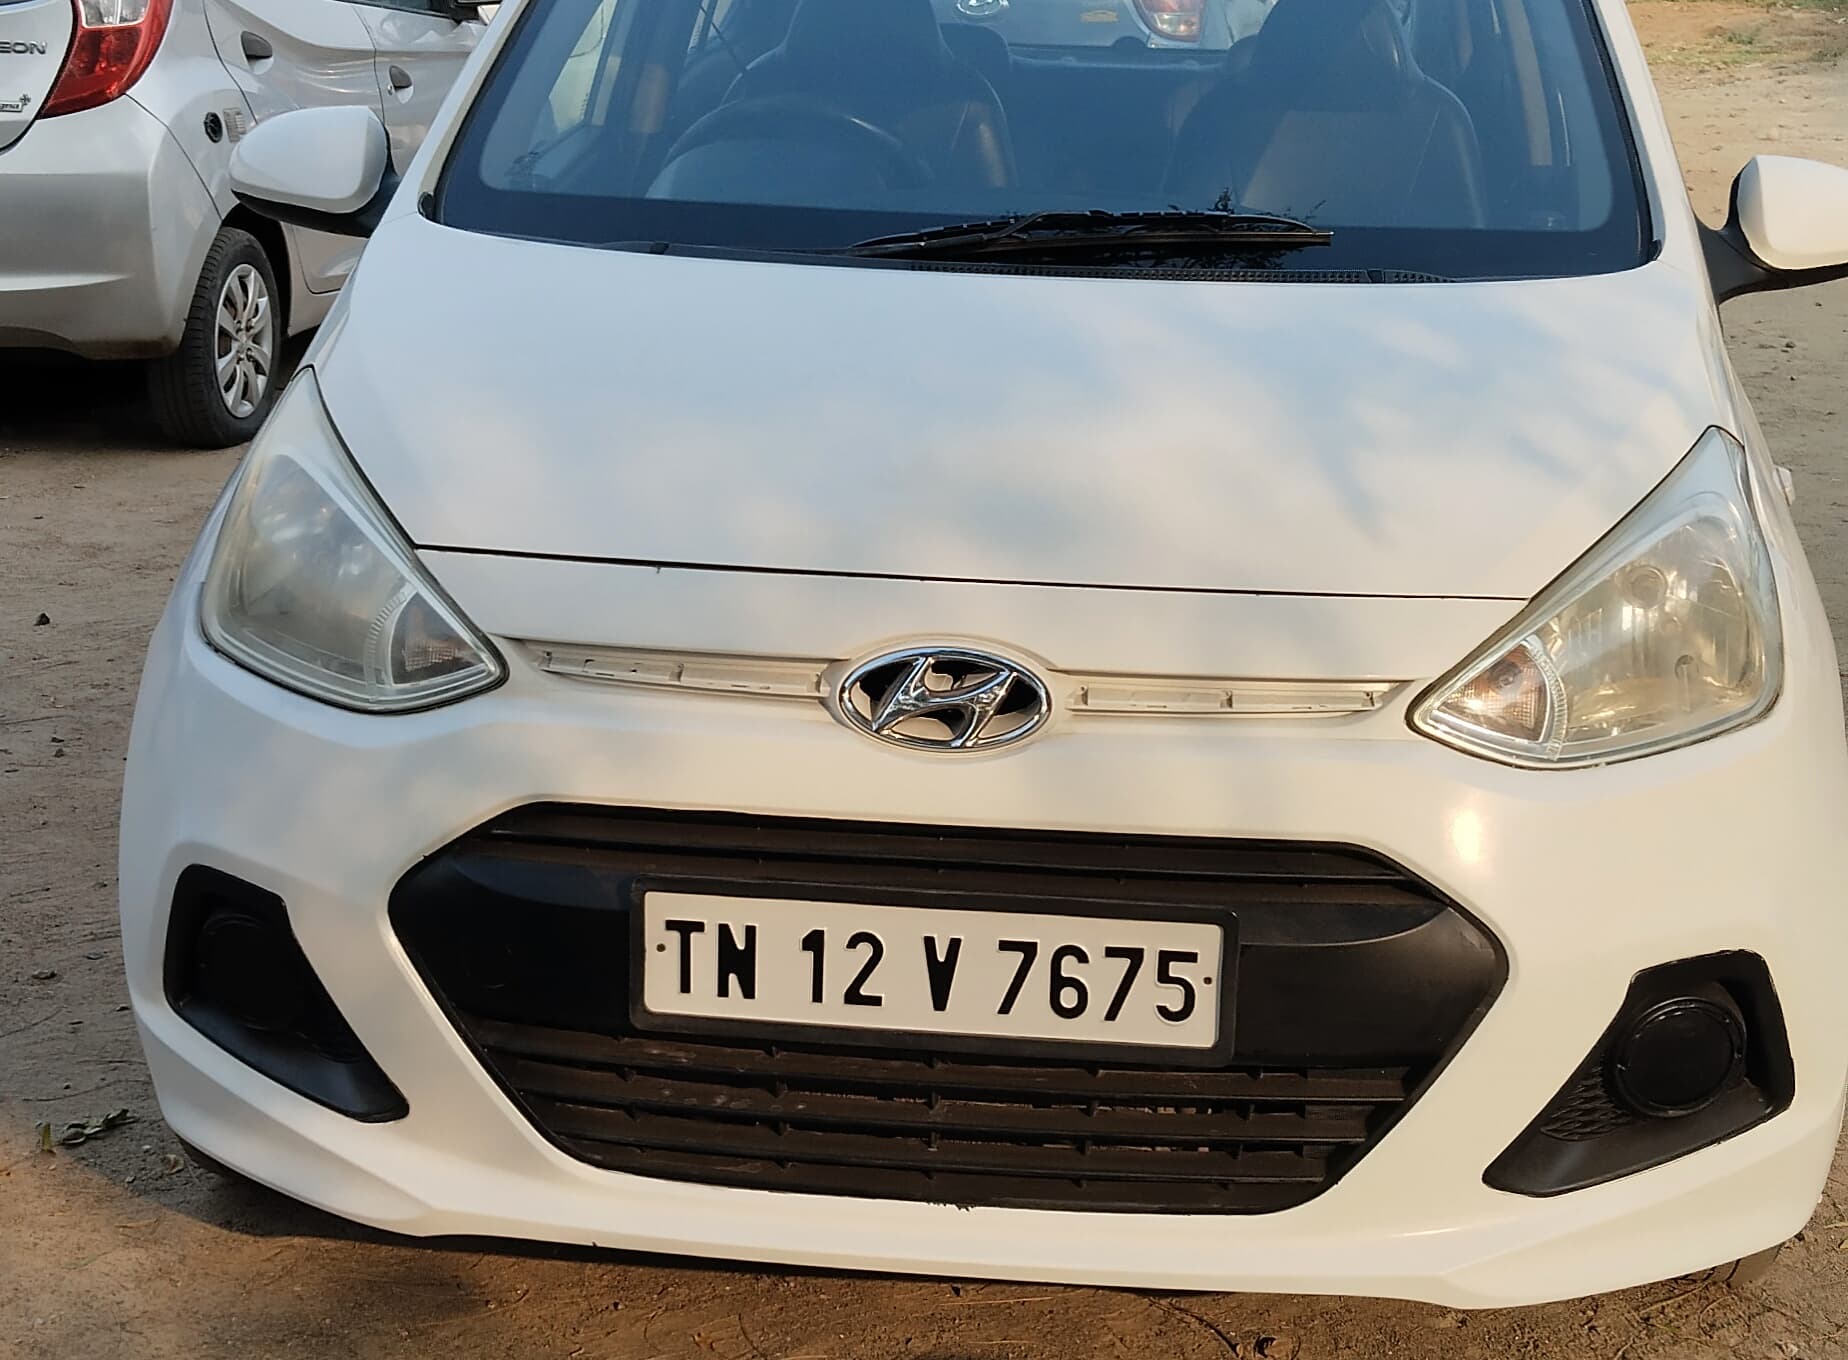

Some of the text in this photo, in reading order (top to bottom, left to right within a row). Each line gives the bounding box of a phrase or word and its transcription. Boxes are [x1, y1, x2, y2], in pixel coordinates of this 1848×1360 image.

[664, 919, 1199, 1024] TN 12 V 7675
